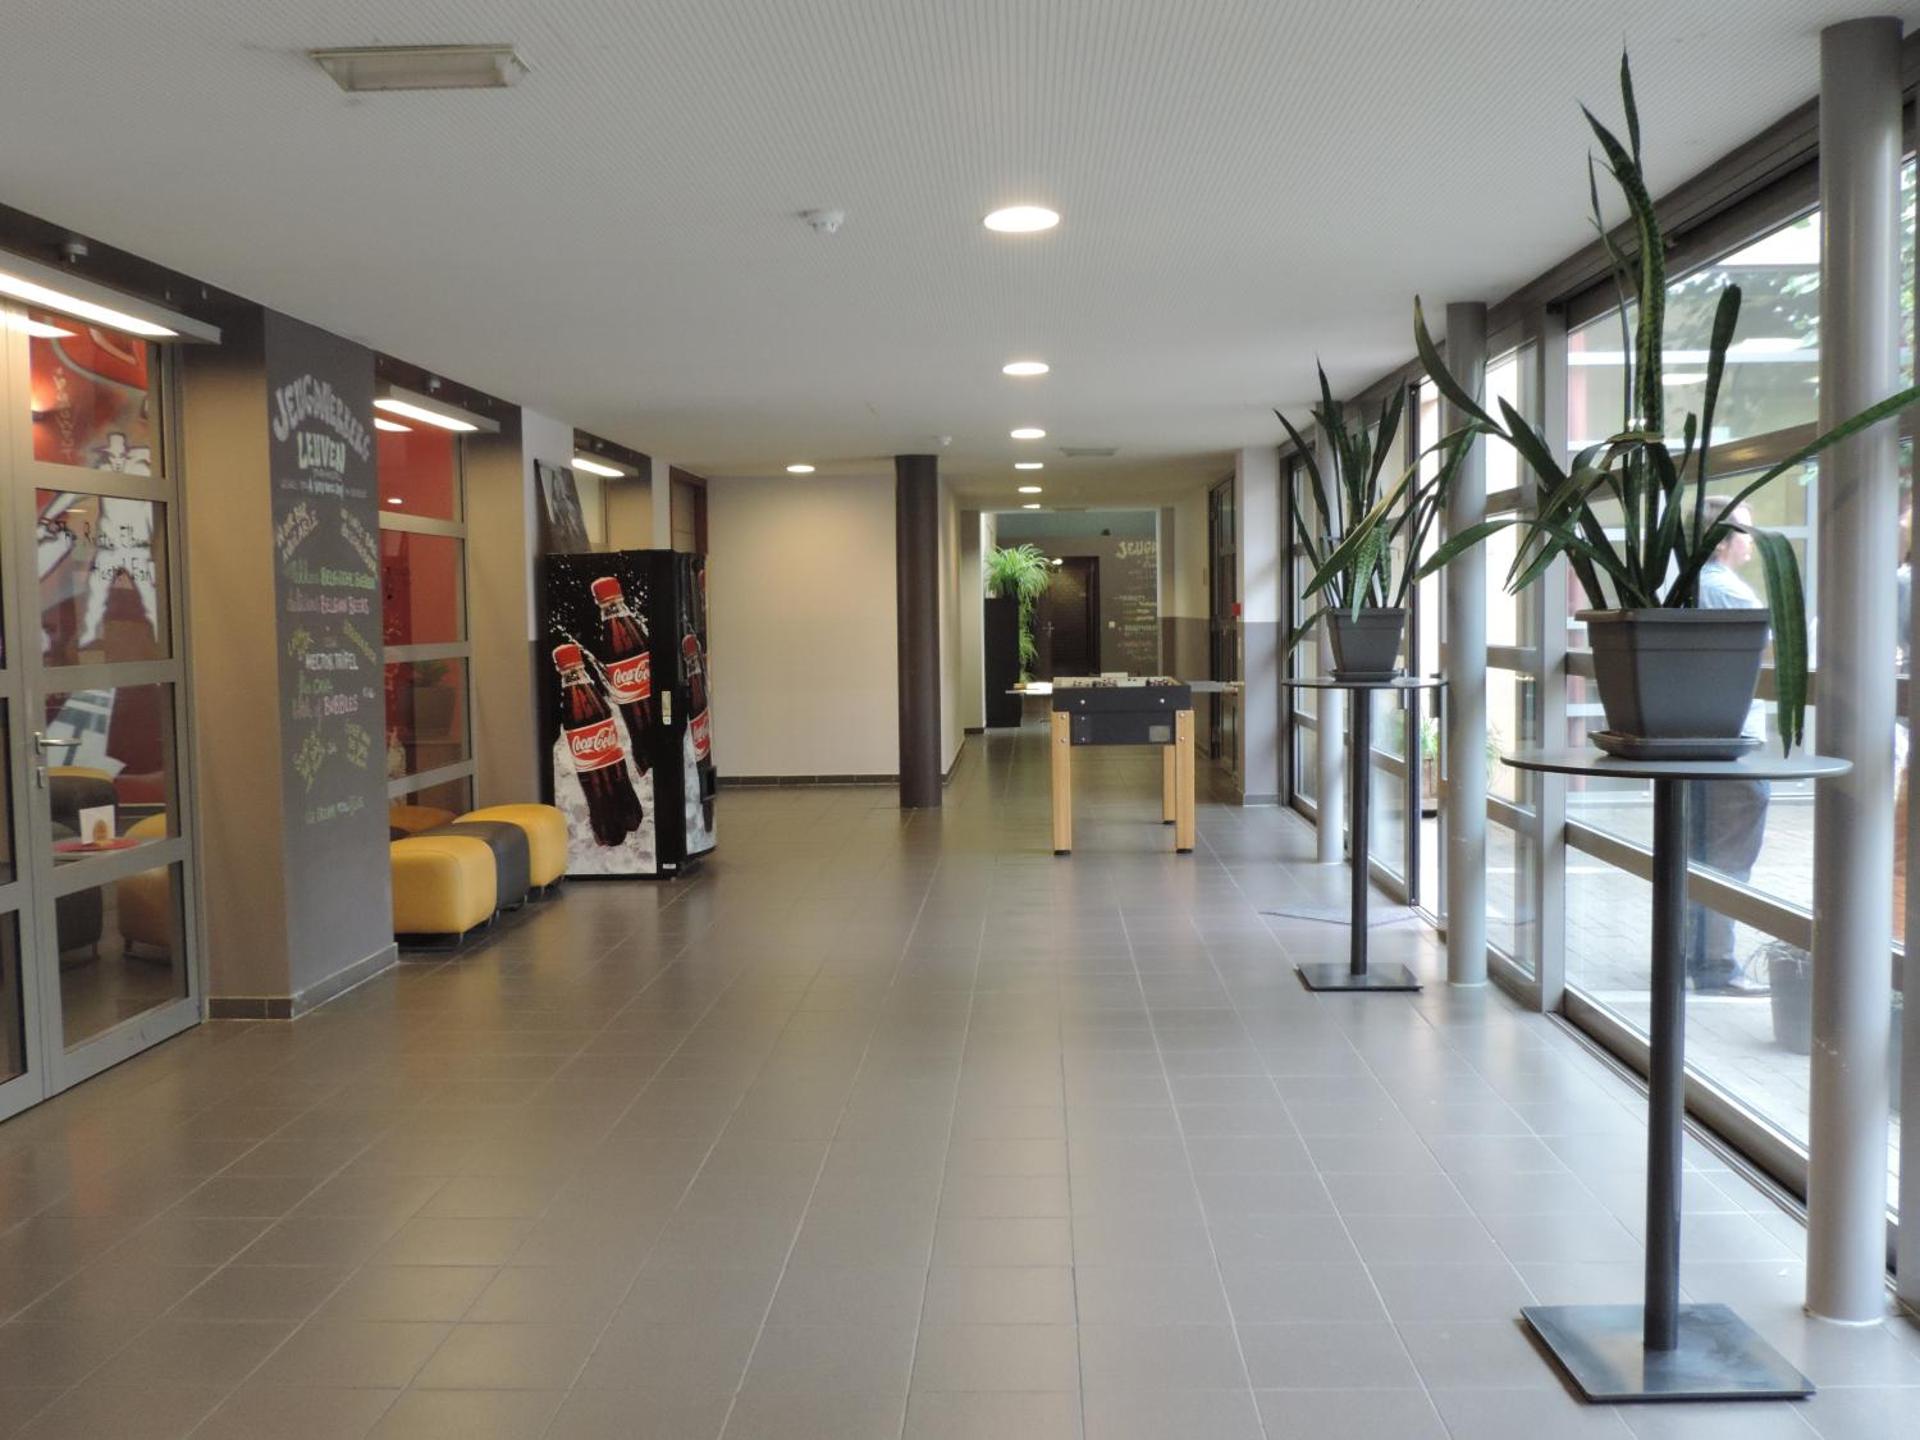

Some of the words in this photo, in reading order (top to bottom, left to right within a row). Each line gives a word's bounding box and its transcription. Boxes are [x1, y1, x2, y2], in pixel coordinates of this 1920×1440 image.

[297, 431, 346, 474] LEUVEN
[1116, 541, 1157, 559] JEUG
[572, 726, 618, 755] Coca-Cola
